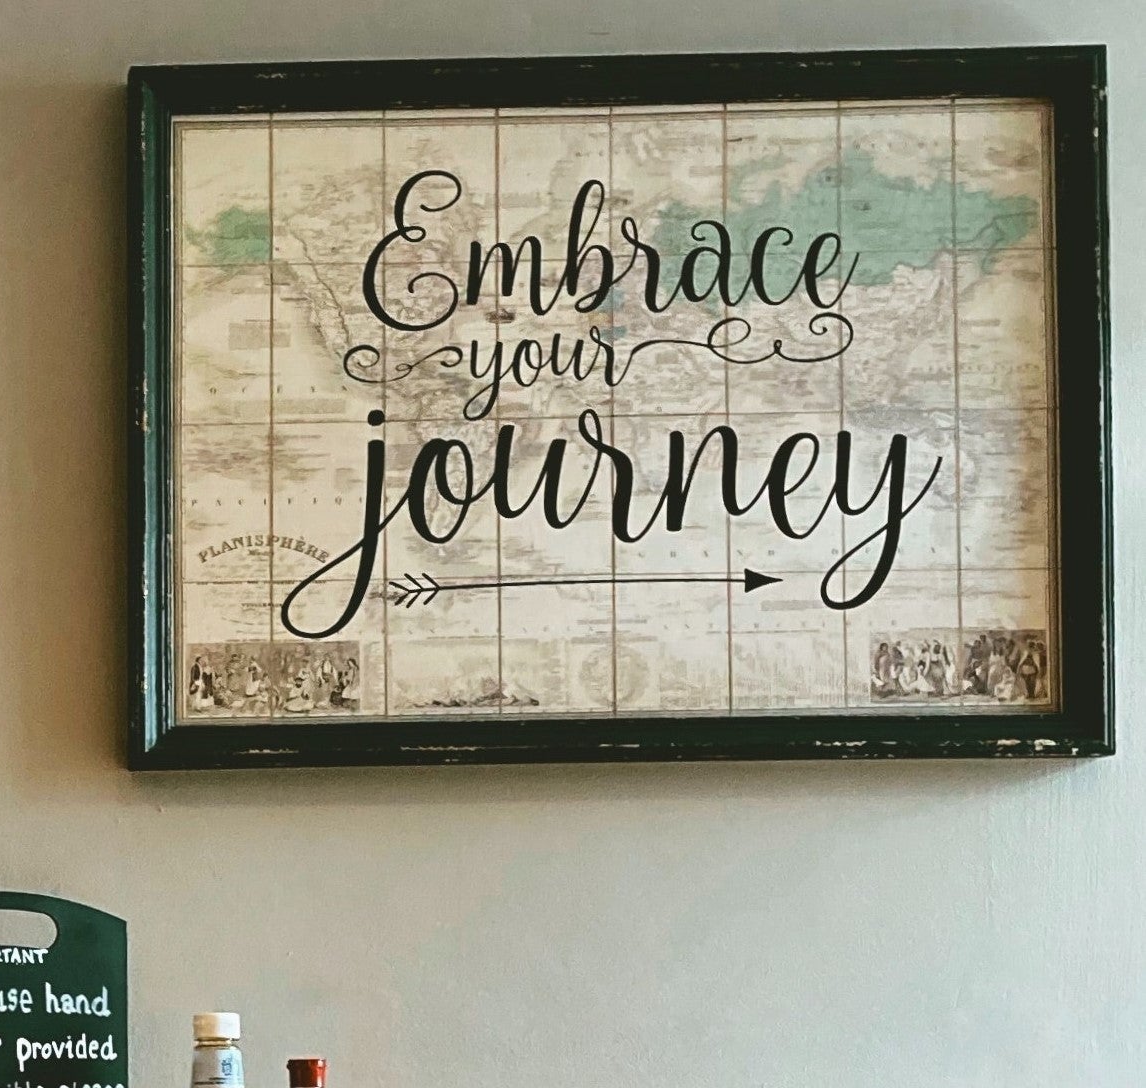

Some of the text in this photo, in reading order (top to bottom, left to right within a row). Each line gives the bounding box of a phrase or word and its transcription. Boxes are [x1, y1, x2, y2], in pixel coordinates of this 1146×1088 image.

[362, 169, 860, 331] Embrace
[463, 326, 634, 421] your
[198, 534, 330, 564] PLANISPHÈRE
[281, 409, 943, 639] journey
[45, 981, 112, 1018] hand
[16, 1032, 118, 1073] provided
